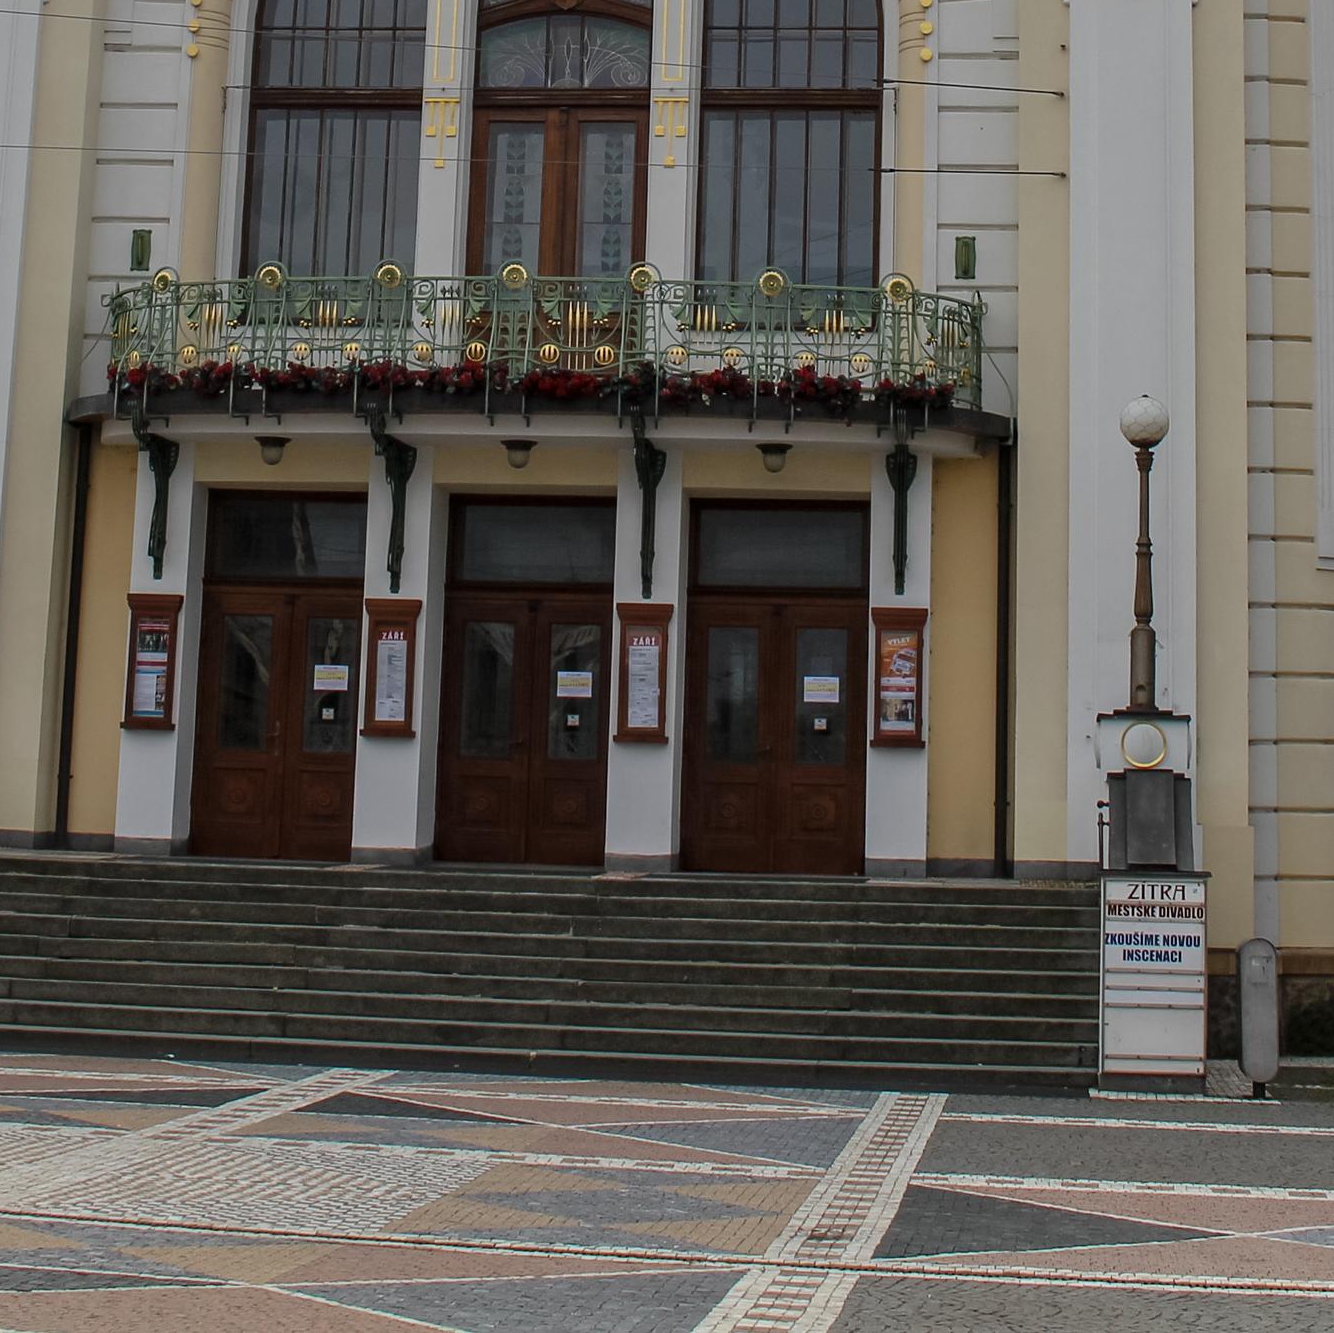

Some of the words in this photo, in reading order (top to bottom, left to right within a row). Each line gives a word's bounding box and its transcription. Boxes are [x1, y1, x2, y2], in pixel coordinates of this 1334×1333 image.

[1128, 881, 1186, 900] ZÍTRA
[1159, 907, 1203, 919] DIVADLO
[1105, 931, 1160, 947] ZKOUŠÍME
[1163, 935, 1200, 948] NOVOU
[1123, 950, 1182, 963] INSCENACI
